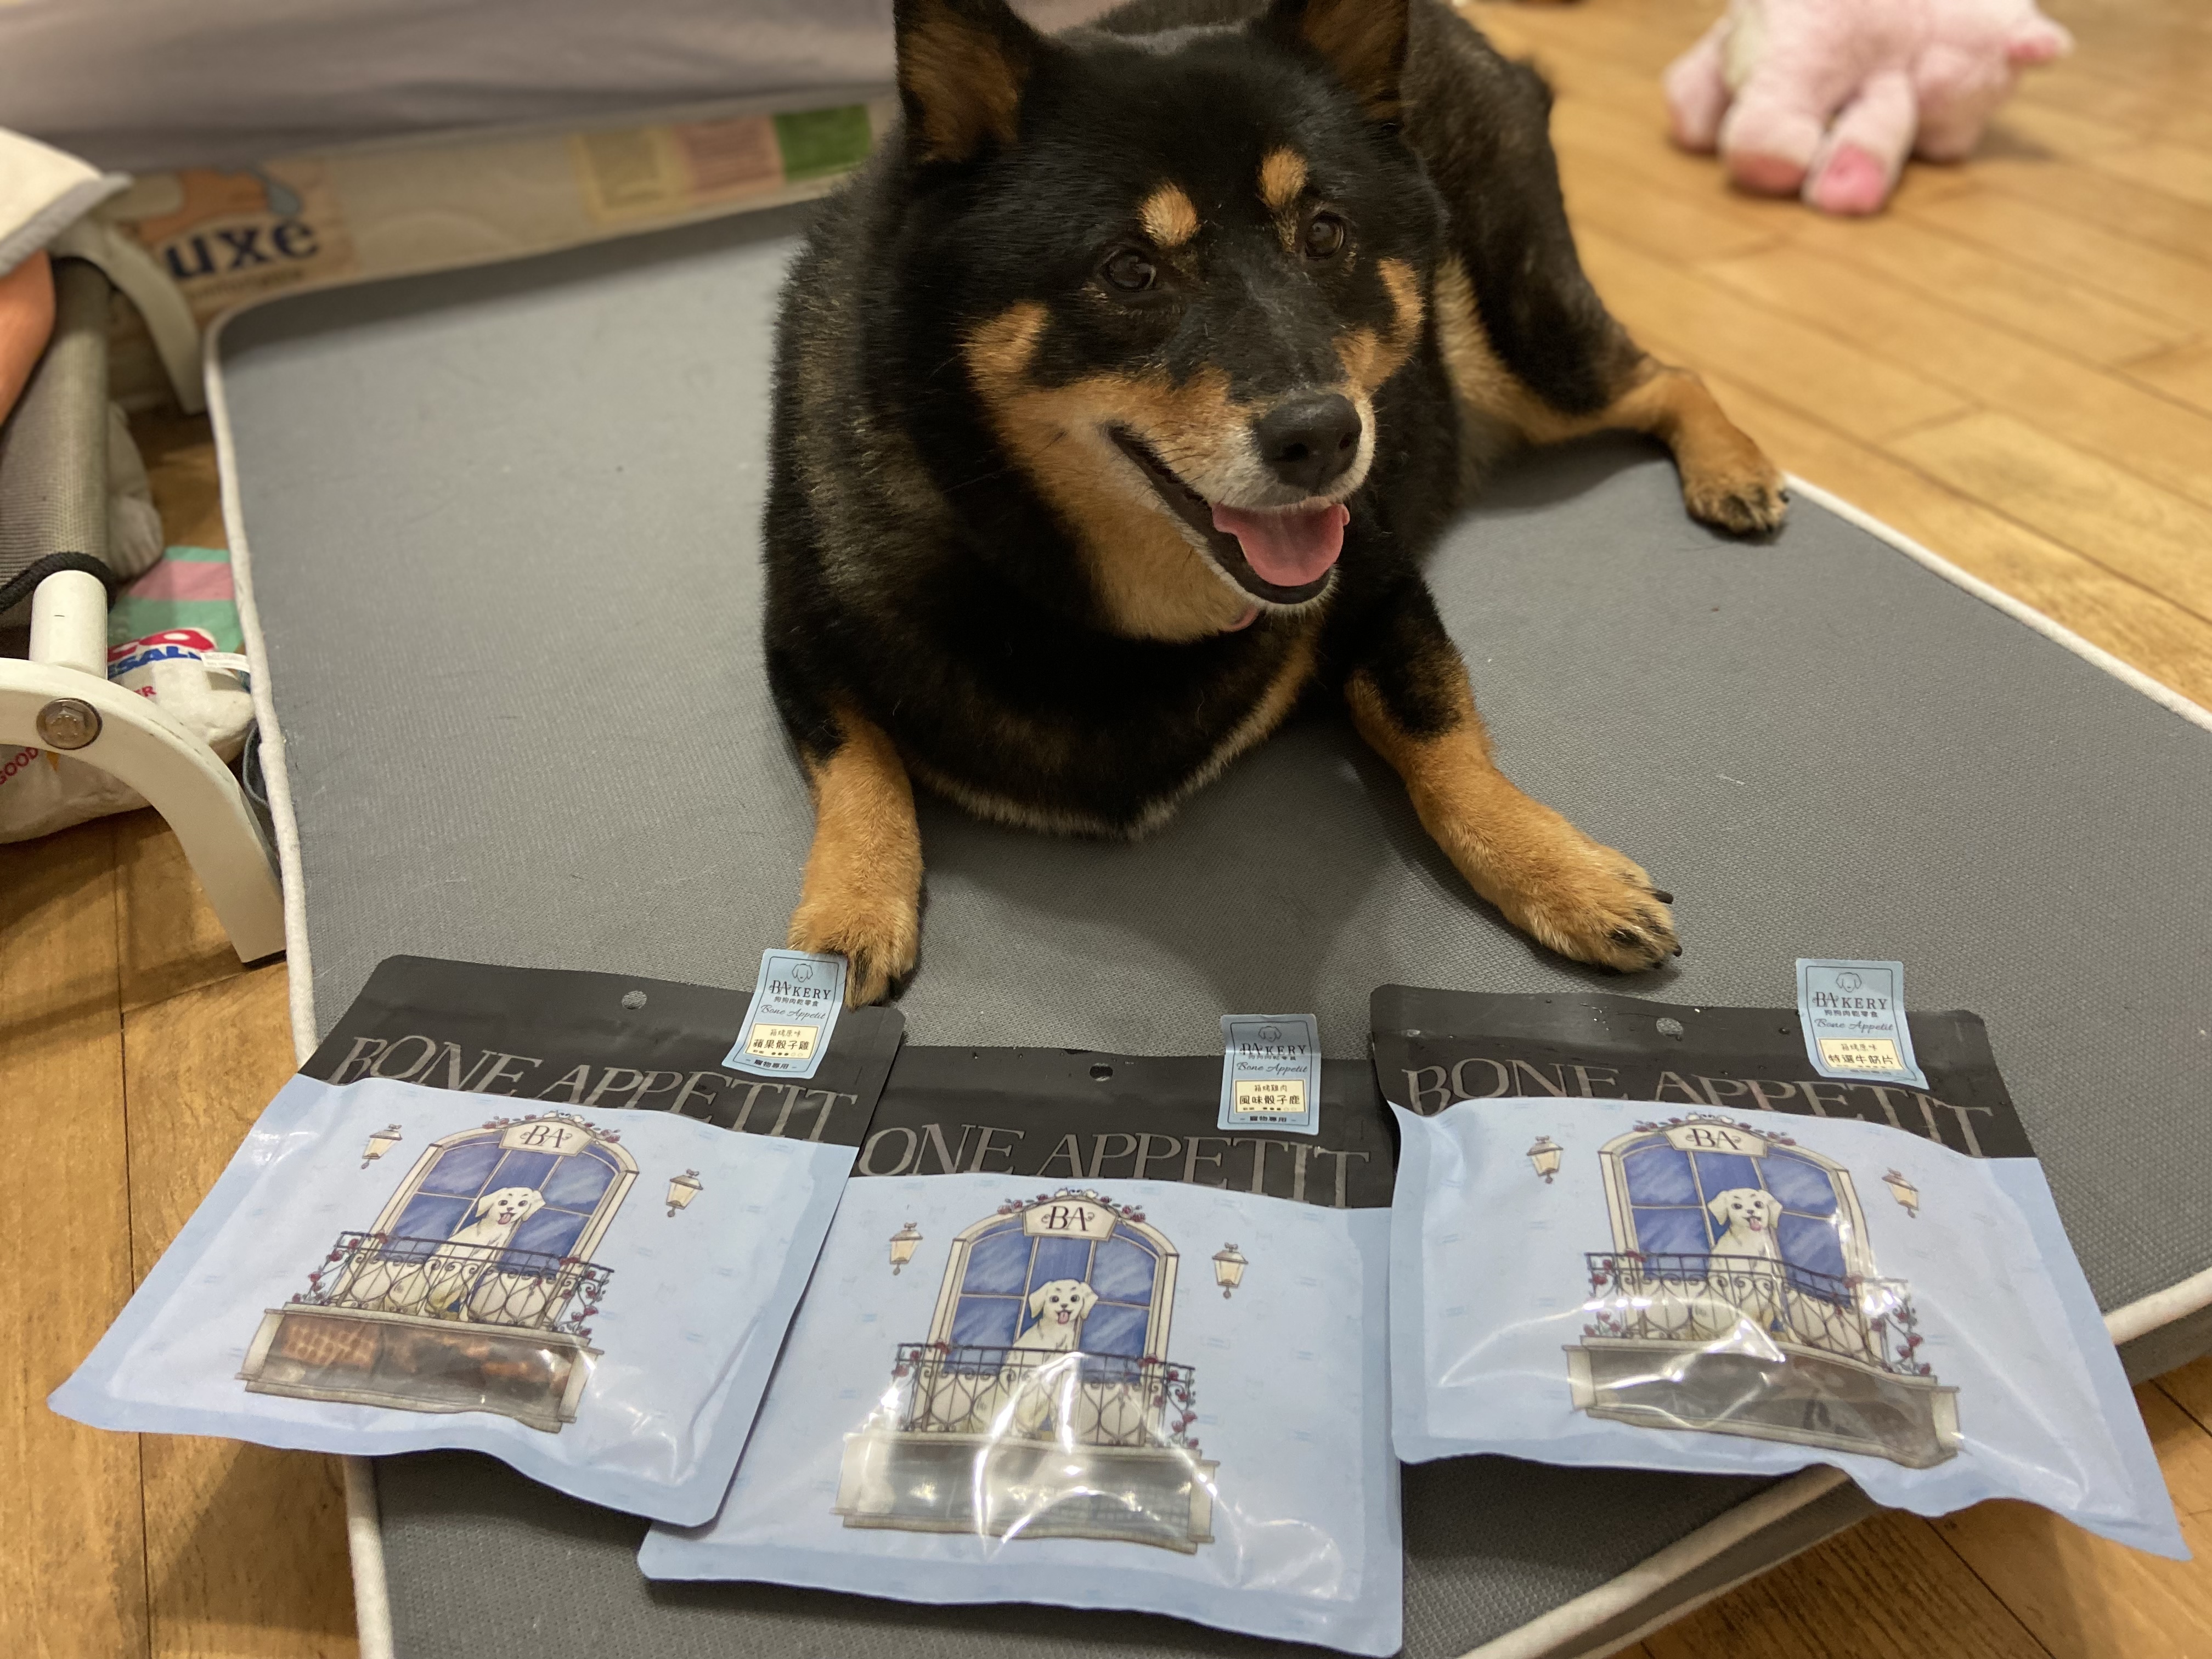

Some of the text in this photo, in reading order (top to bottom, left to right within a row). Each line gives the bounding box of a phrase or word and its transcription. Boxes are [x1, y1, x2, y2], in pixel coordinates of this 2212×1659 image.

[769, 980, 831, 1000] BAKERY
[1812, 991, 1888, 1009] BAKERY
[760, 1004, 826, 1020] Bone Appetit
[1814, 1018, 1894, 1033] Bone Appetit
[753, 1039, 810, 1051] 蘋果骰子雞
[1237, 1062, 1308, 1076] Bone Appetit
[328, 1035, 859, 1143] BONE APPETIT
[1239, 1094, 1300, 1105] 風味骰子鹿
[1401, 1058, 1994, 1158] BONE APPETIT
[520, 1125, 572, 1148] BA
[1685, 1128, 1742, 1150] BA
[858, 1123, 1370, 1208] ONE APPETIT
[1041, 1205, 1095, 1232] BA
